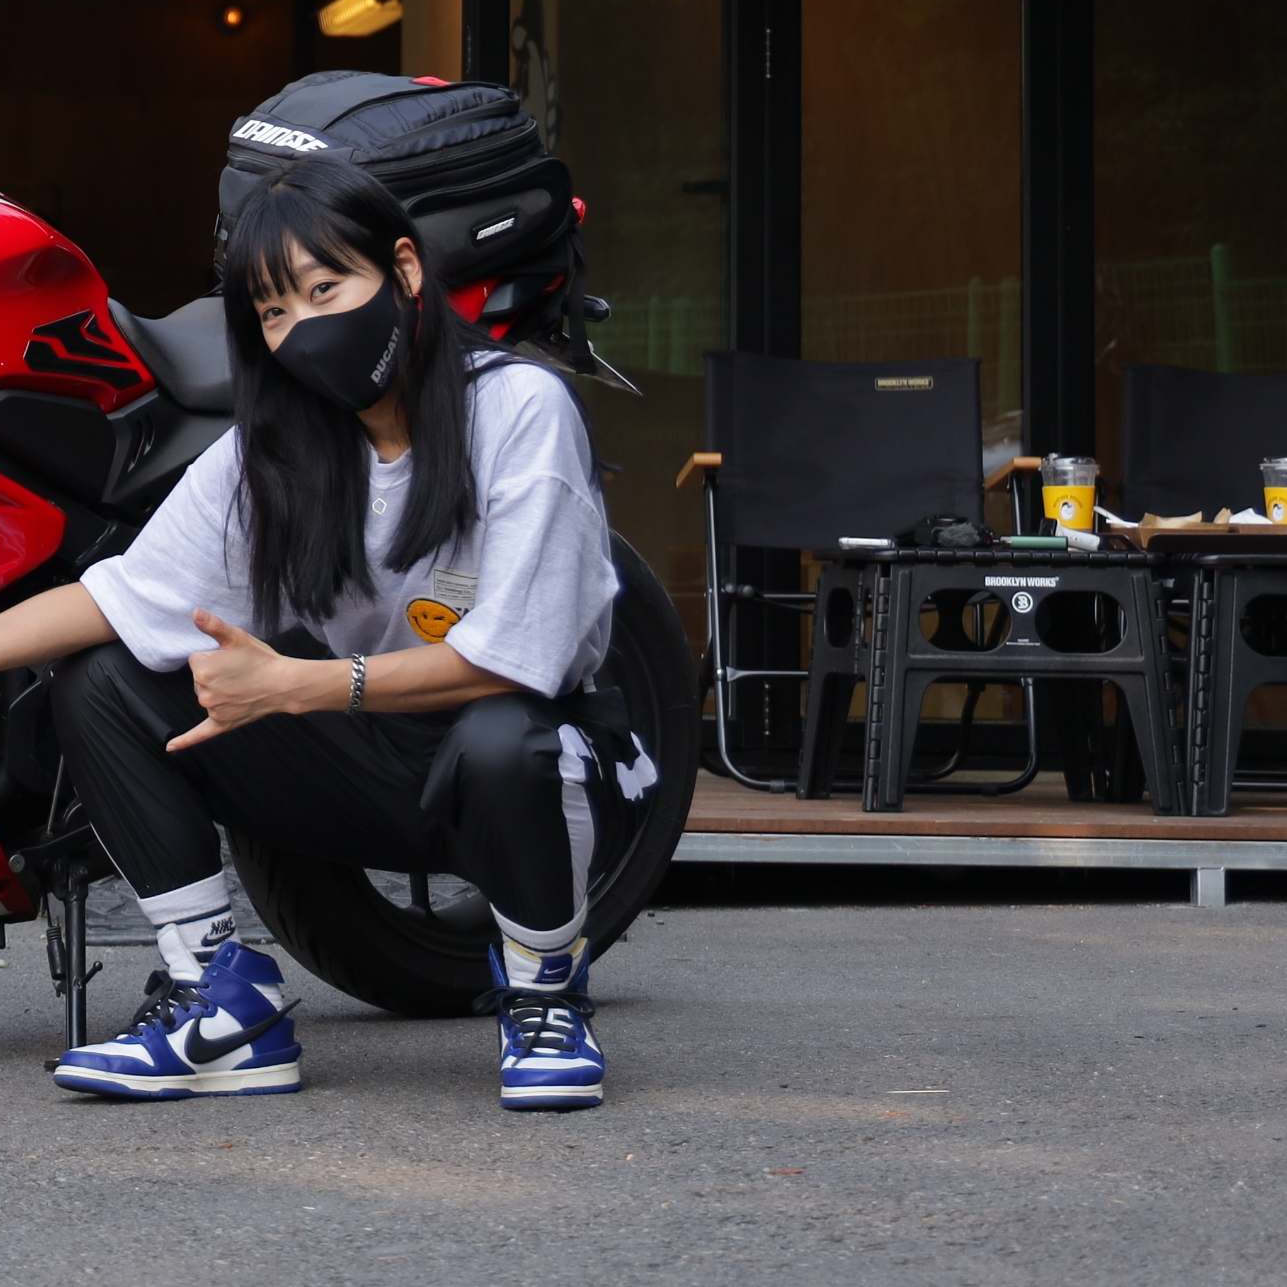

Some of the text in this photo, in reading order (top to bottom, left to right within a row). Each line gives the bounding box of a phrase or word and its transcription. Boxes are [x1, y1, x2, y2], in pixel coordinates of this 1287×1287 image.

[233, 119, 328, 152] DAINESE
[370, 325, 400, 384] DUCATI
[984, 576, 1026, 587] BROOKLYN
[209, 916, 234, 936] NIKE
